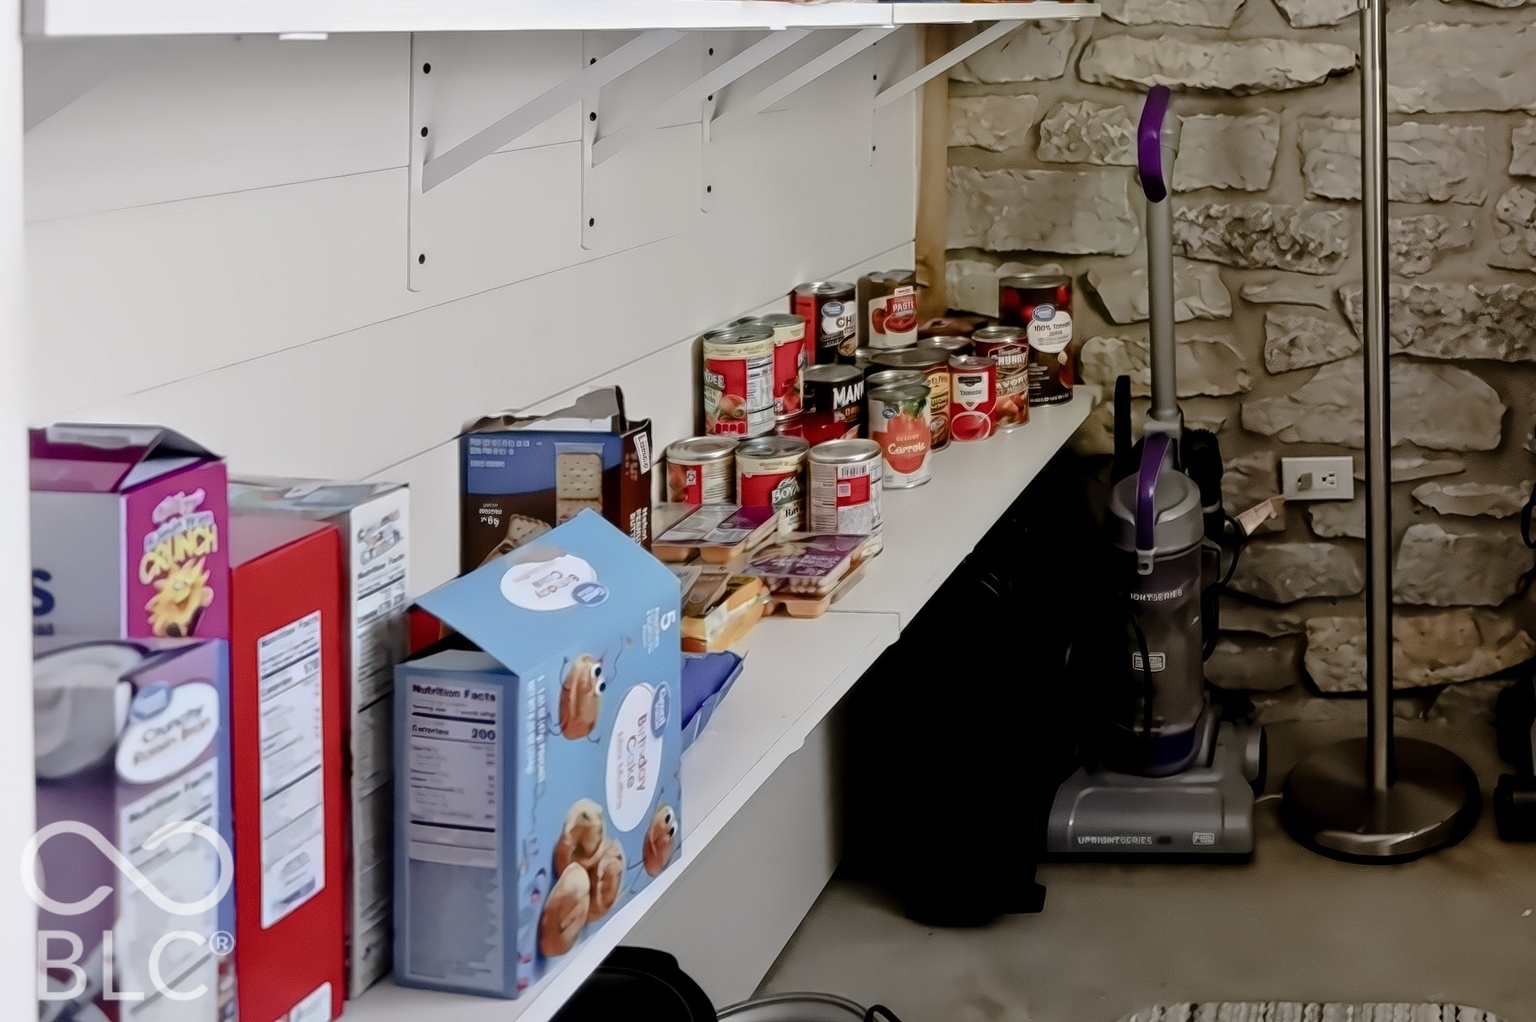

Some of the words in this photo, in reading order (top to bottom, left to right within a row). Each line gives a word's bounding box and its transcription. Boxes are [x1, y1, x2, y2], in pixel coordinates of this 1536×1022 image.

[887, 441, 926, 456] Carrots
[660, 610, 677, 632] 5
[411, 683, 461, 699] Nutrition
[463, 687, 496, 702] Facts
[471, 727, 496, 741] 200
[626, 734, 638, 790] Cake
